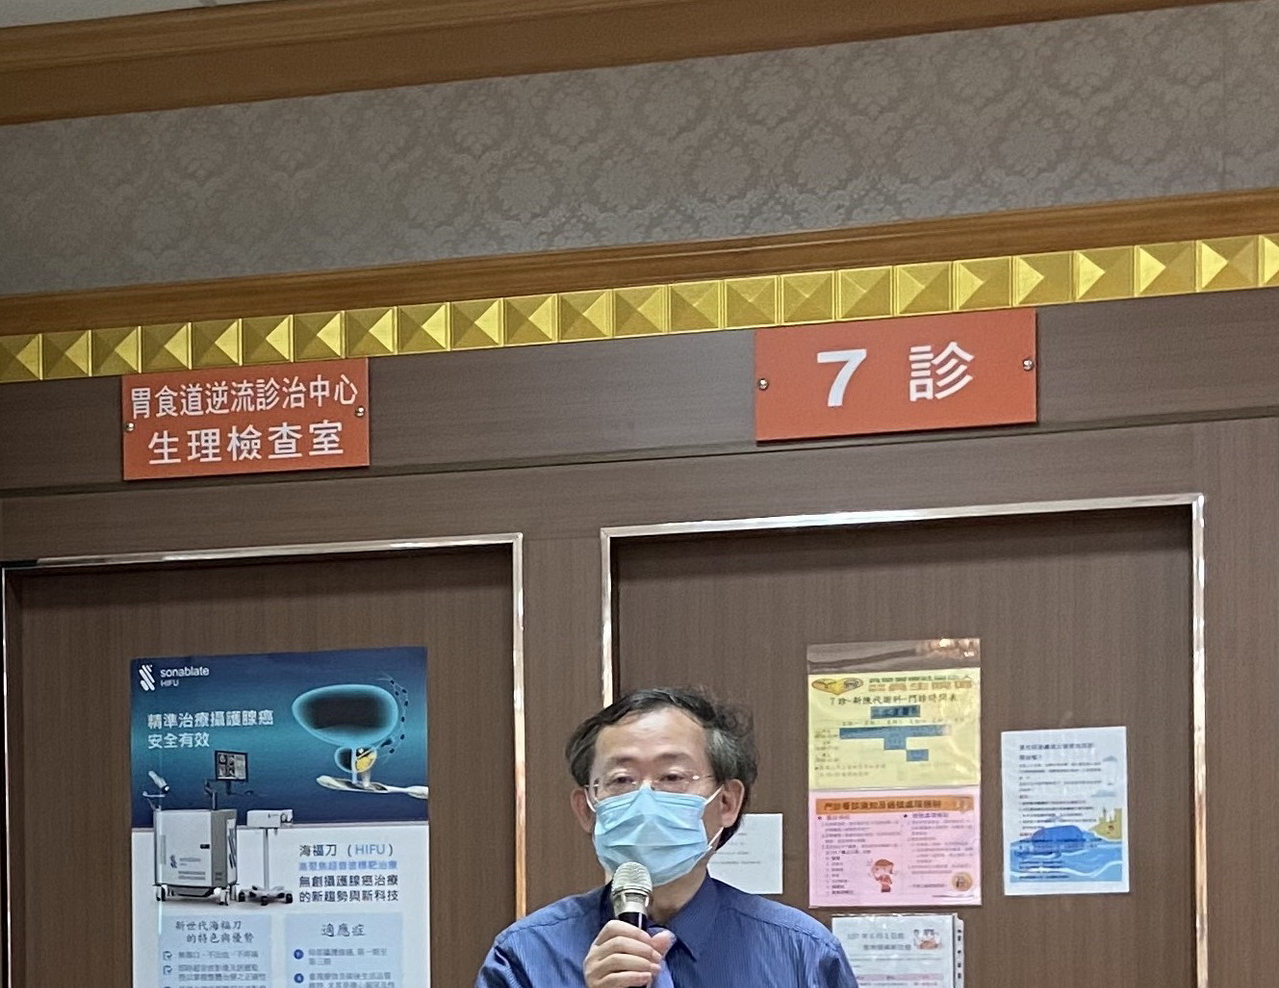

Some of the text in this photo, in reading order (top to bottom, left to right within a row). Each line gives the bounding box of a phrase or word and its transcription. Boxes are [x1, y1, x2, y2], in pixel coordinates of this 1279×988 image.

[131, 373, 358, 419] 胃食道逆流診治中心
[817, 341, 974, 407] 7 診
[148, 419, 344, 465] 生理檢查室
[160, 666, 210, 678] sonablate
[147, 731, 210, 750] 安全有效
